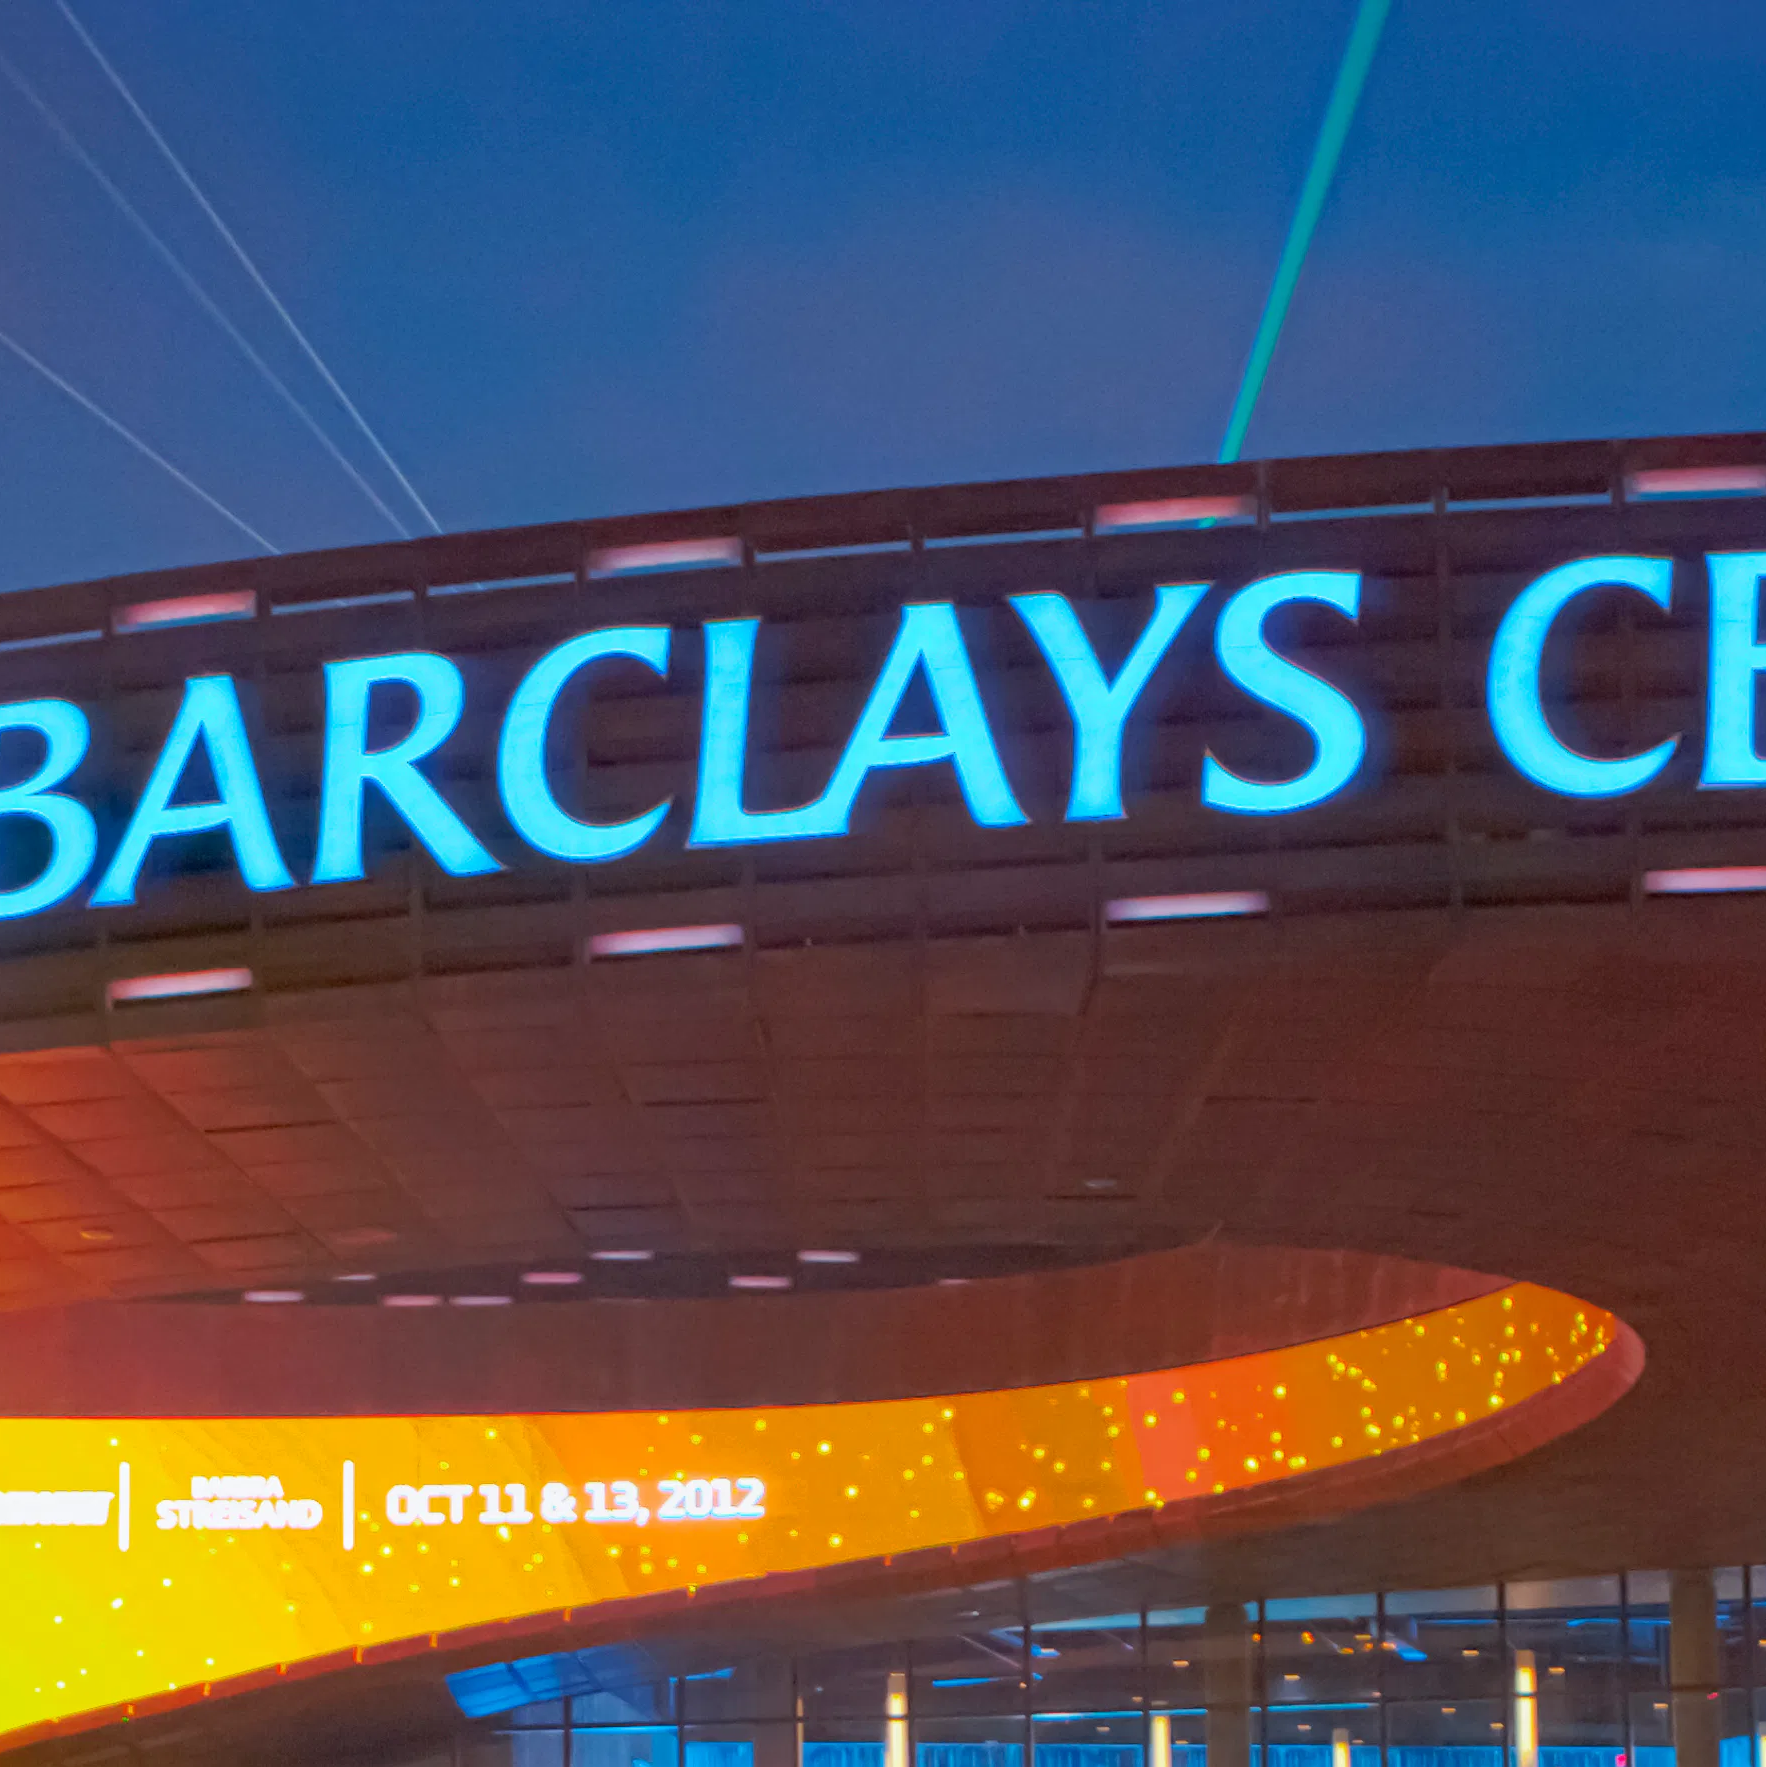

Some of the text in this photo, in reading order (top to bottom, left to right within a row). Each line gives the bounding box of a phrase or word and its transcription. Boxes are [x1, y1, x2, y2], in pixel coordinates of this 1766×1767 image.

[385, 1475, 766, 1527] OCT 11 & 13, 2012
